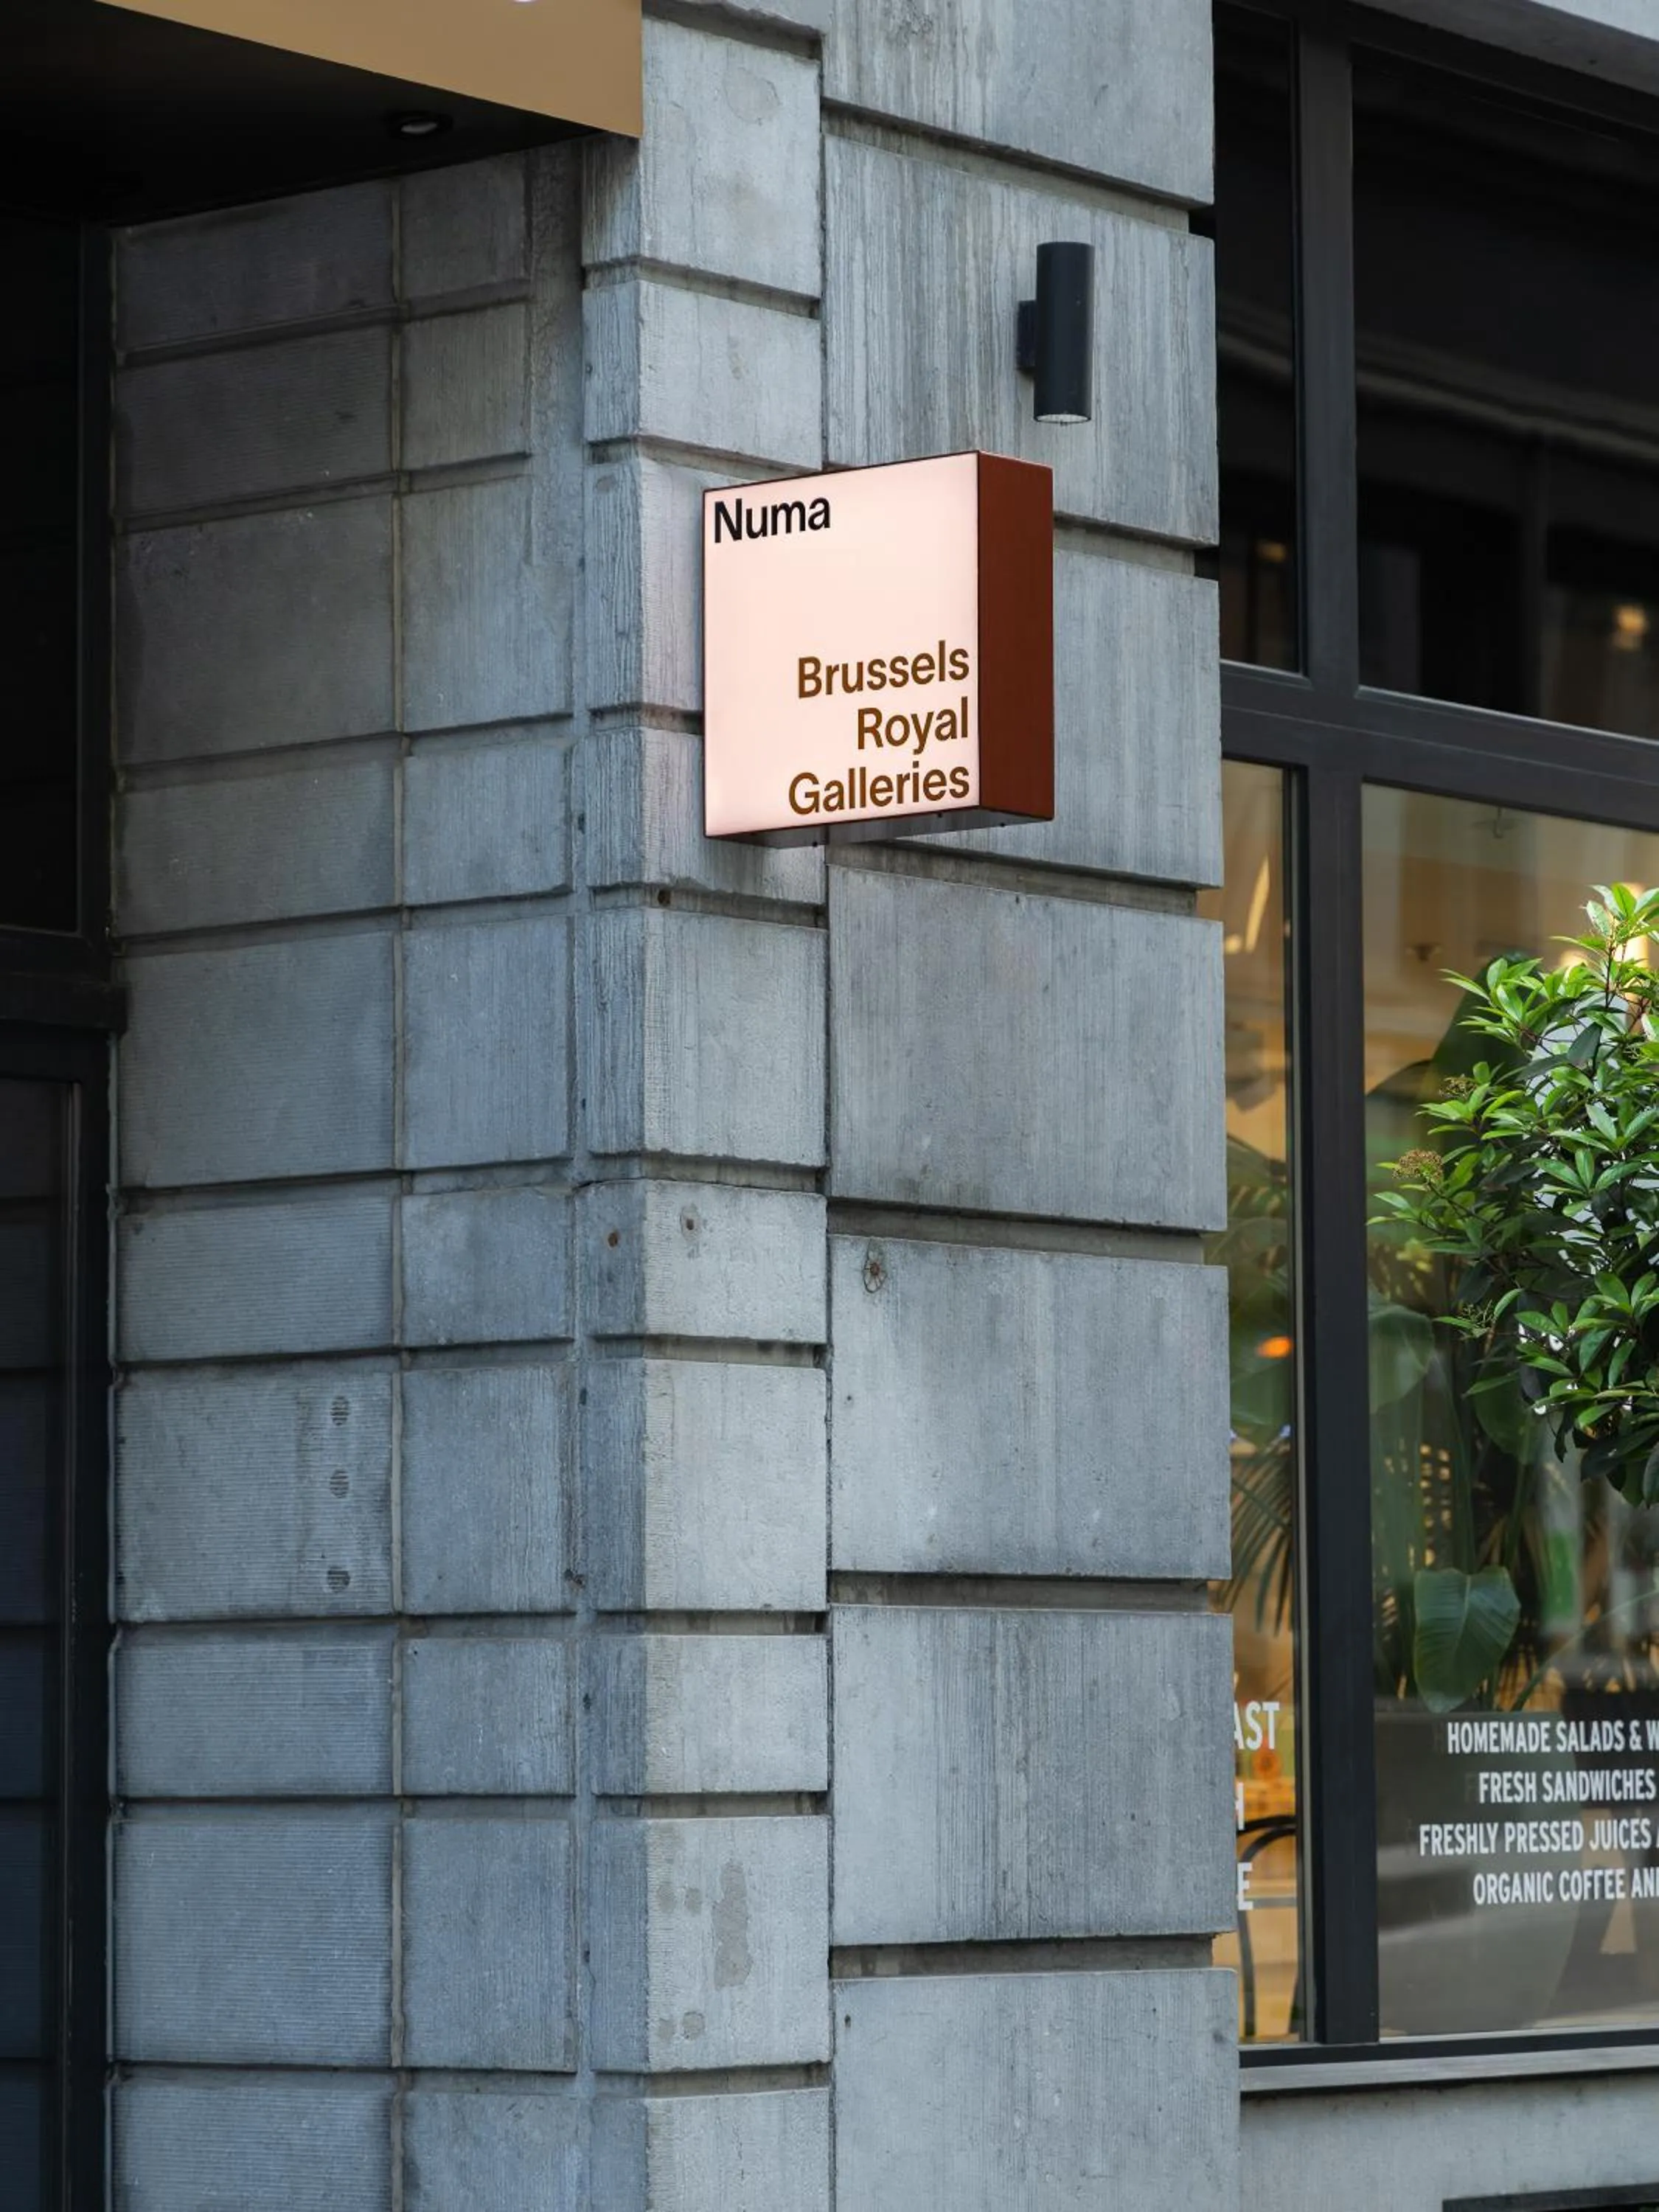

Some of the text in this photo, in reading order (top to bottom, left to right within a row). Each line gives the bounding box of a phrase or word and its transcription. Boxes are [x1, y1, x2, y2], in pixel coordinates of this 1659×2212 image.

[714, 497, 831, 544] Numa
[798, 639, 970, 699] Brussels
[857, 695, 969, 755] Royal
[788, 760, 970, 815] Galleries
[1447, 1722, 1552, 1754] HOMEMADE
[1556, 1720, 1625, 1753] SALADS
[1630, 1719, 1643, 1751] &
[1479, 1769, 1656, 1804] FRESH SANDWICHES
[1419, 1822, 1499, 1857] FRESHLY
[1504, 1820, 1585, 1854] PRESSED
[1588, 1818, 1652, 1851] JUICES
[1472, 1871, 1554, 1905] ORGANIC
[1559, 1867, 1627, 1902] COFFEE
